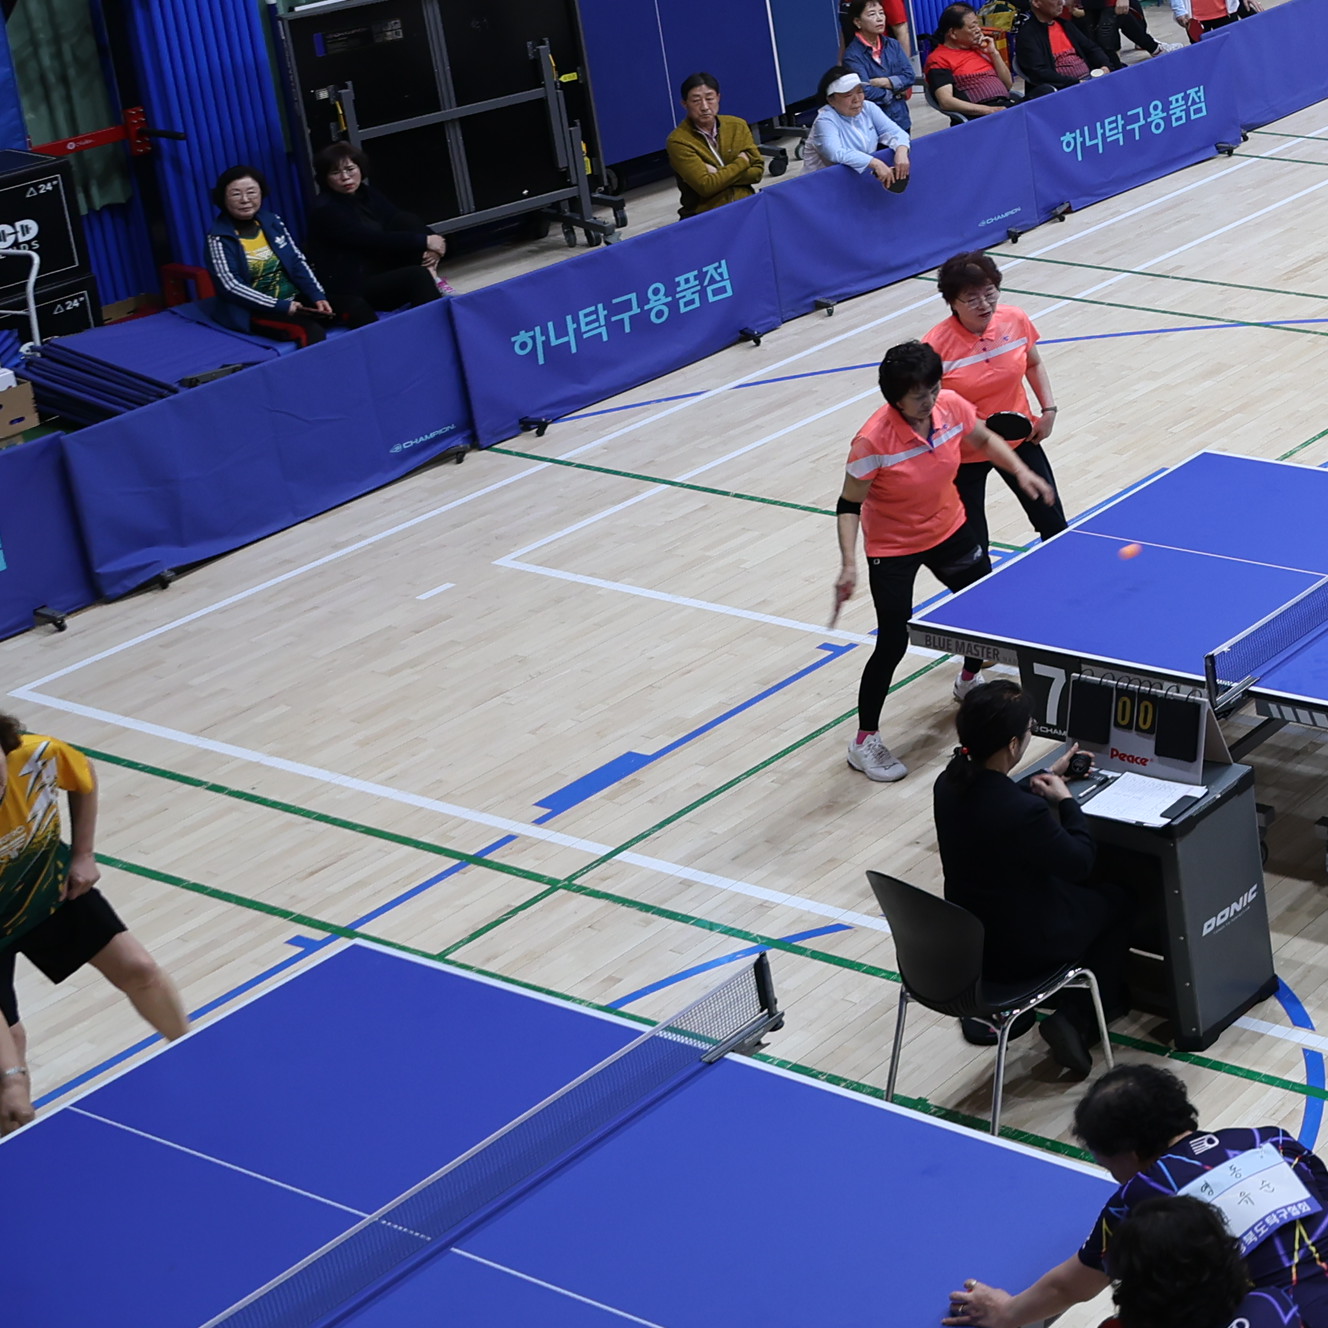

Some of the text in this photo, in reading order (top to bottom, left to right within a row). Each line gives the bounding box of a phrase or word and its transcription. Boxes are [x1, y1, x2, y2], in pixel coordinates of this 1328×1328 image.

[1060, 85, 1207, 162] 하나탁구용품점
[985, 207, 1022, 225] CHAMPION
[511, 259, 733, 365] 하나탁구용품점
[402, 425, 457, 449] CHAMPION
[924, 634, 1000, 662] BLUE MASTER
[1032, 662, 1067, 726] 7
[1110, 747, 1149, 767] Peace
[1202, 883, 1258, 937] DONIC
